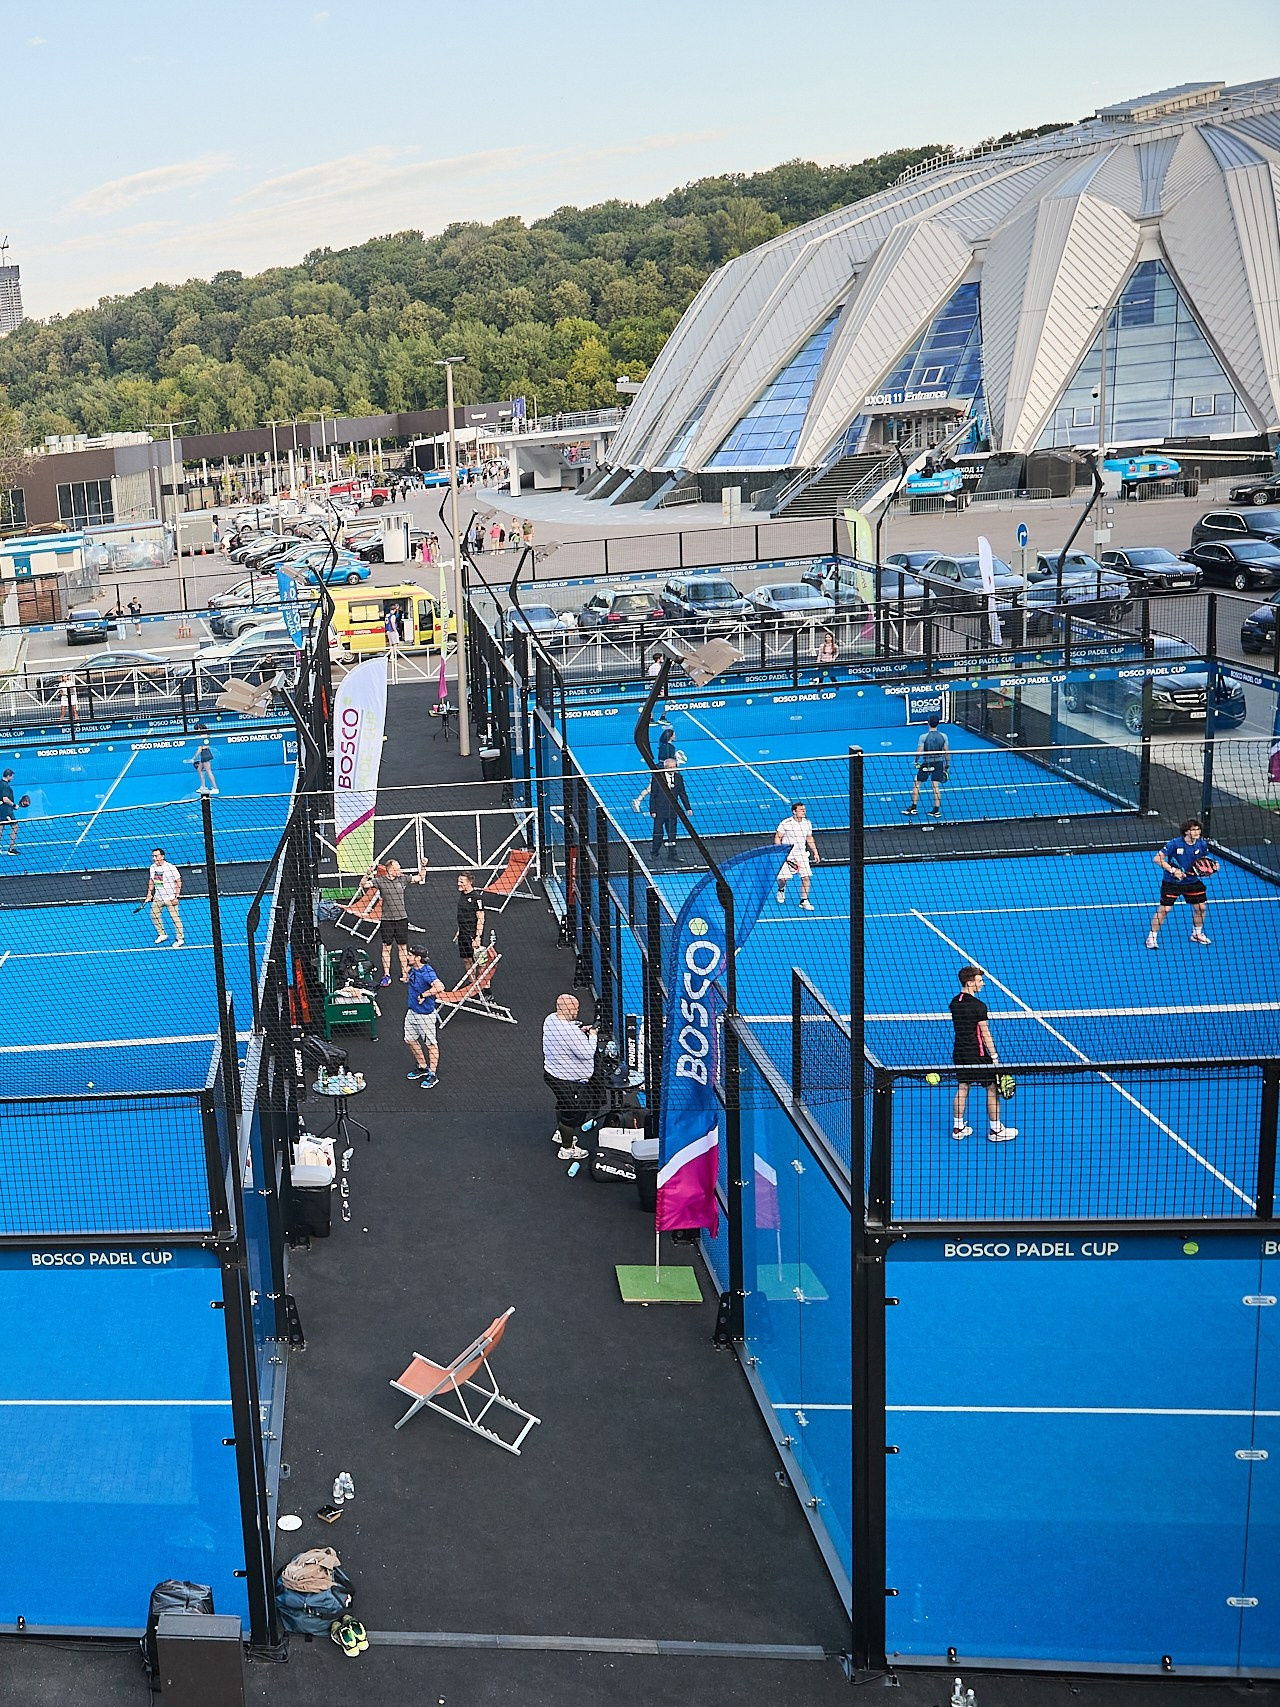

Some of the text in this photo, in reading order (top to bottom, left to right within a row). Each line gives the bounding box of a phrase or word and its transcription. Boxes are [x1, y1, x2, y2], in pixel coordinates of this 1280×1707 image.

[865, 393, 902, 405] ВХОД 11
[905, 391, 947, 401] Entrance
[954, 658, 977, 666] BOSCO
[979, 657, 999, 665] PADEL
[848, 666, 871, 674] BOSCO
[872, 665, 892, 673] PADEL
[1119, 666, 1186, 677] BOSCO PADEL CUP
[1000, 675, 1066, 686] BOSCO PADEL CUP
[885, 684, 949, 694] BOSCO PADEL CUP
[773, 693, 836, 703] BOSCO PADEL CUP
[911, 698, 940, 707] BOSCO
[665, 701, 726, 711] BOSCO PADEL CUP
[583, 710, 603, 718] PADEL
[605, 709, 618, 717] CUP
[250, 734, 268, 742] PADEL
[339, 708, 359, 789] BOSCO
[676, 940, 721, 1086] BOSCO
[628, 1037, 636, 1067] FONBET
[294, 1049, 303, 1077] FONBET
[595, 1162, 636, 1180] HEAD
[945, 1243, 1119, 1257] BOSCO PADEL CUP
[32, 1252, 172, 1266] BOSCO PADEL CUP
